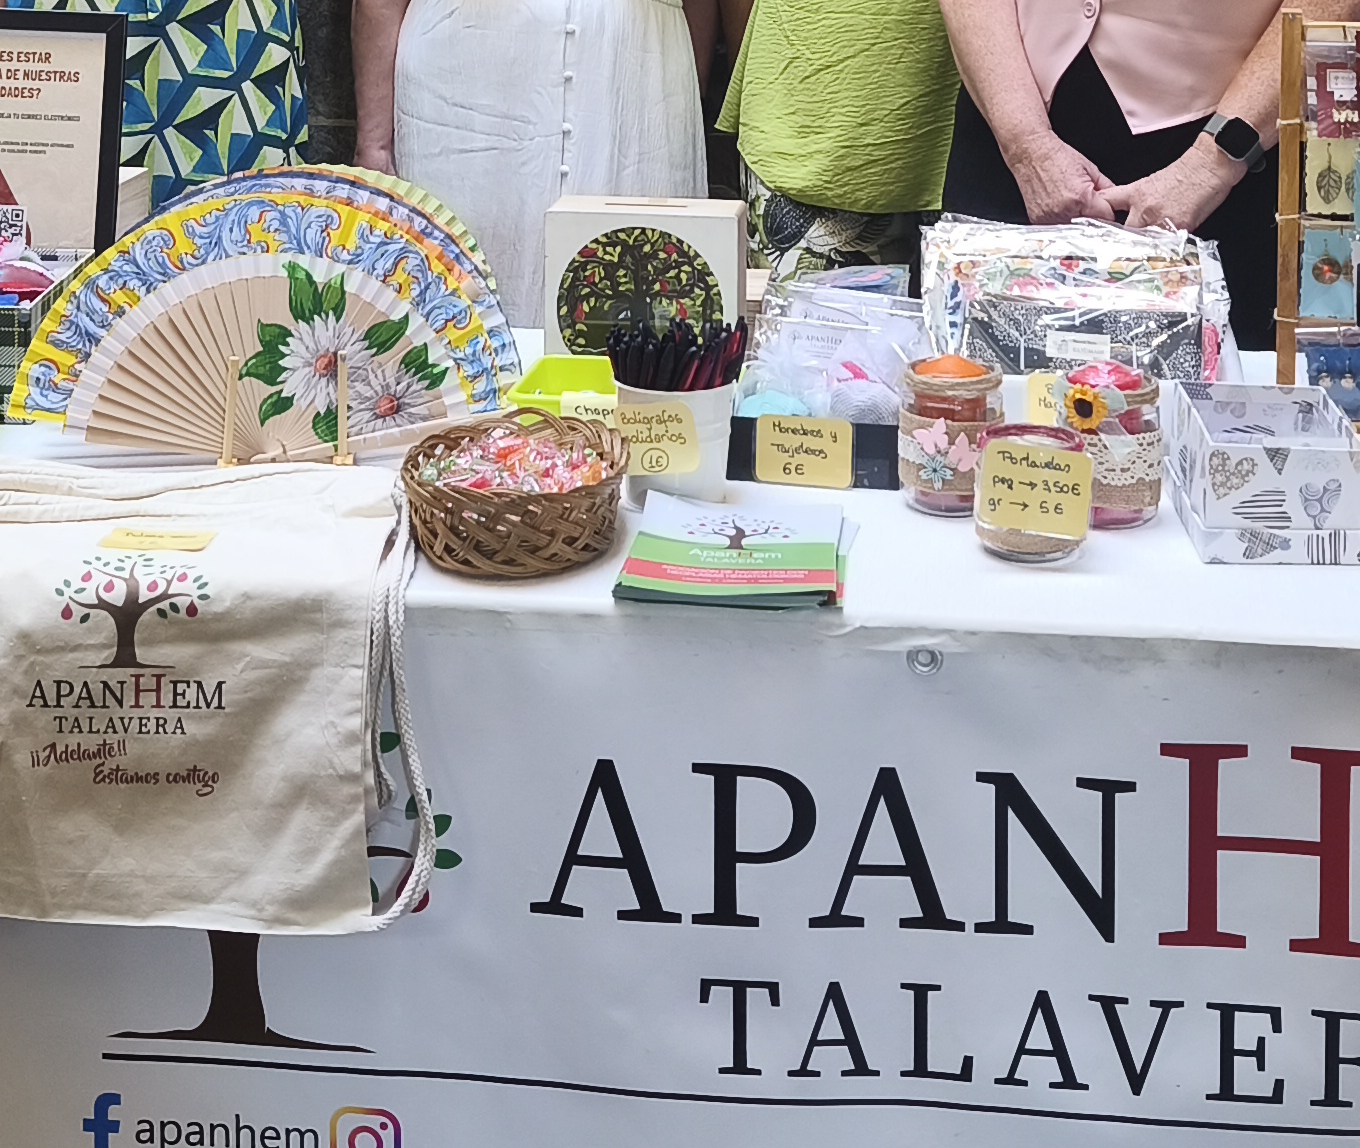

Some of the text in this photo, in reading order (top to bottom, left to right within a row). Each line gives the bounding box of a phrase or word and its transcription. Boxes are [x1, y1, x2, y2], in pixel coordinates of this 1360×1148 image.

[16, 52, 52, 64] ESTAR
[5, 69, 20, 81] DE
[22, 70, 80, 83] NUESTRAS
[629, 429, 687, 445] olidarios
[830, 431, 838, 443] y
[782, 462, 805, 475] 6€
[25, 672, 227, 711] APANHEM
[53, 715, 187, 735] TALAVERA
[92, 761, 220, 797] Estamos contigo
[135, 1113, 320, 1148] apanhem
